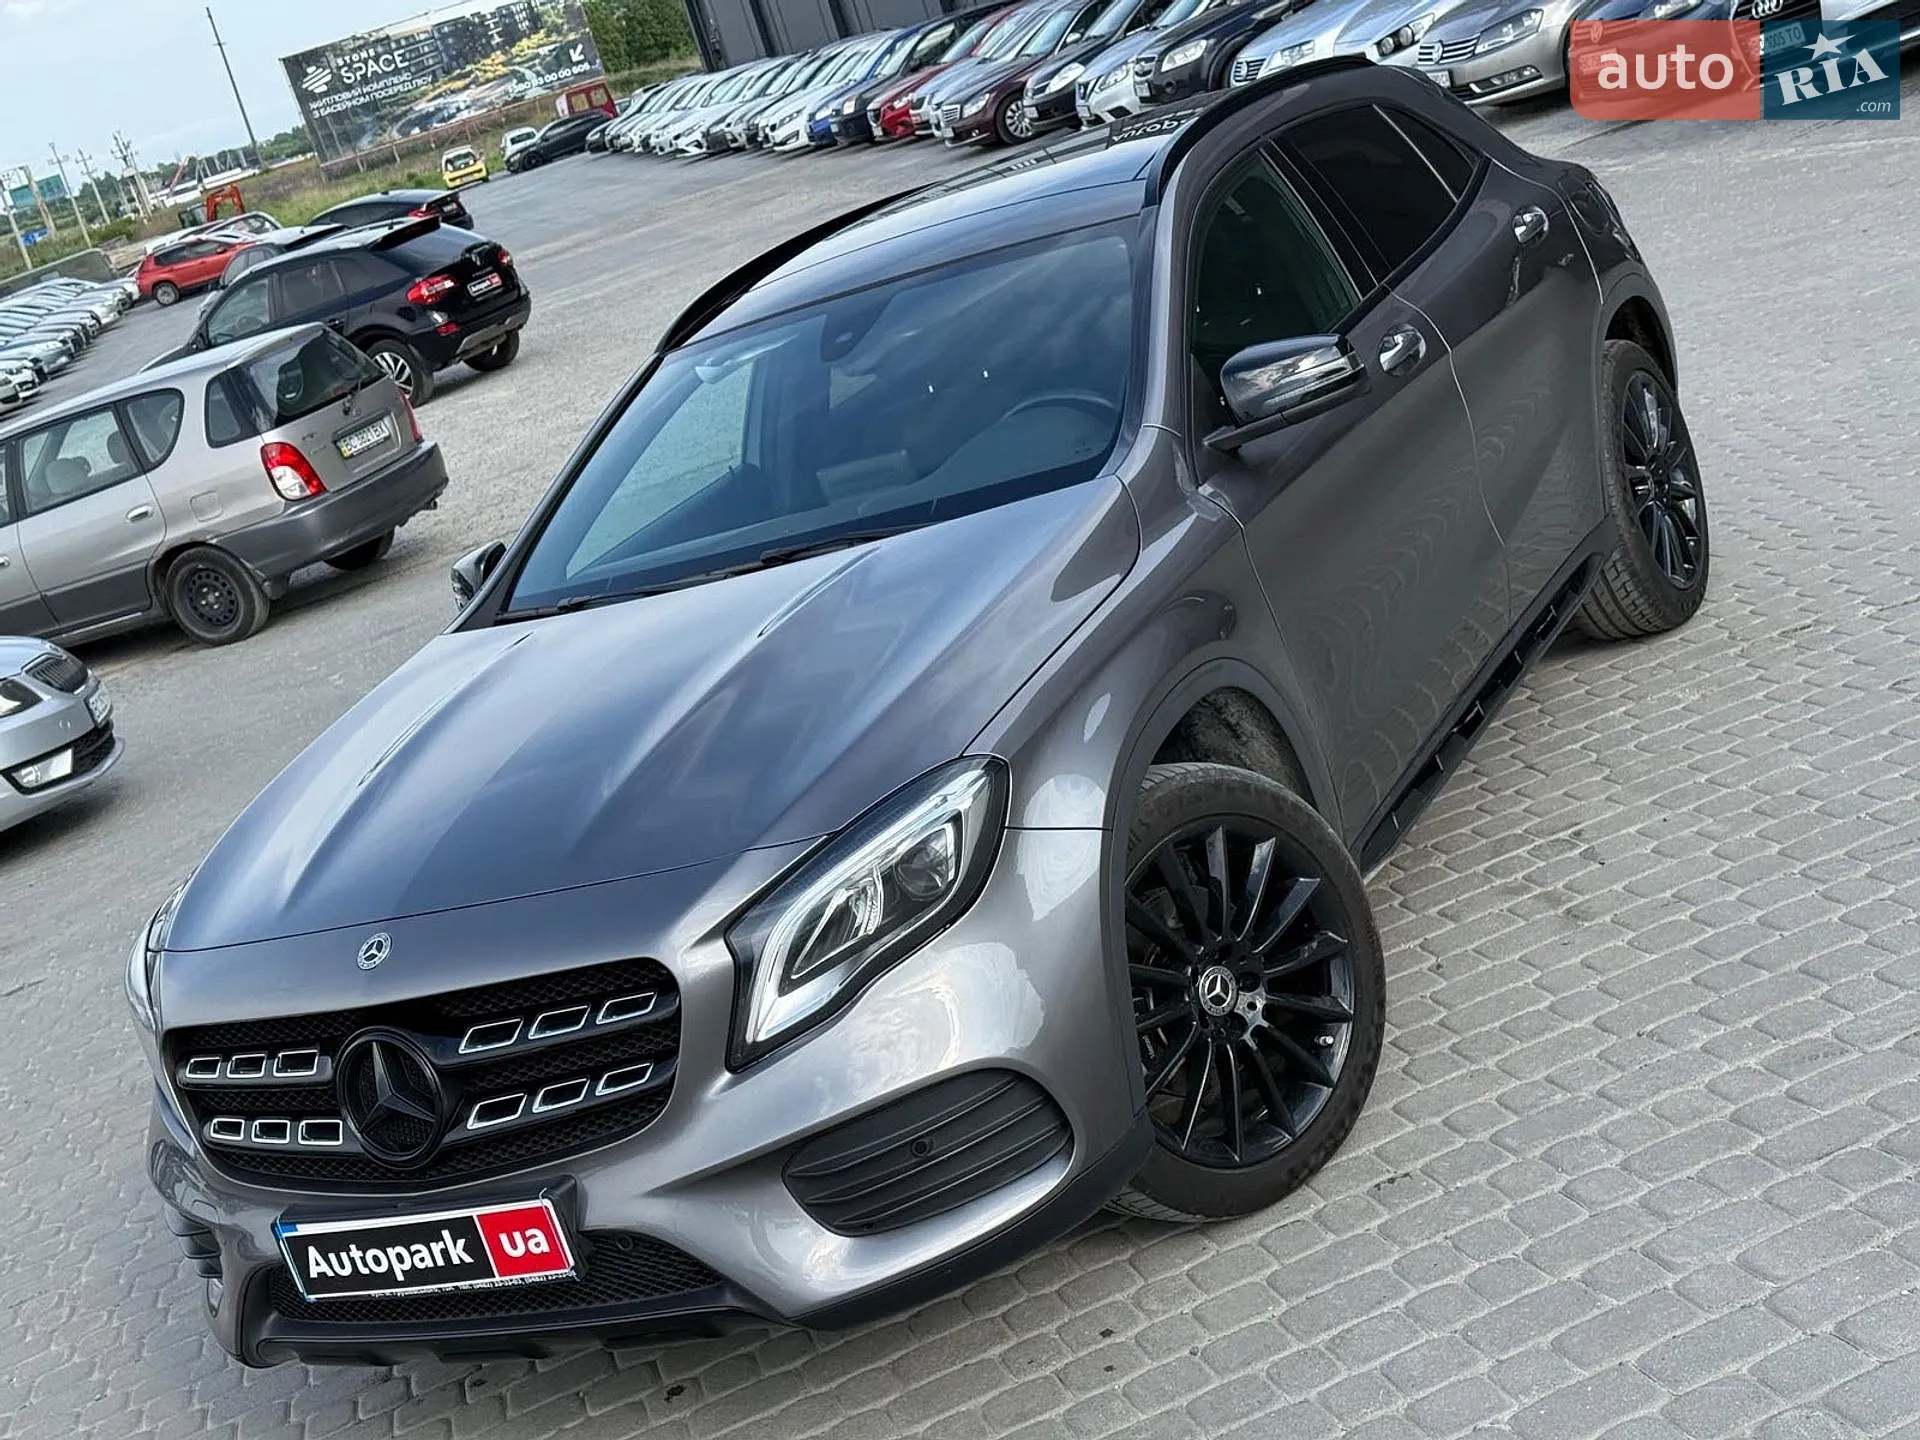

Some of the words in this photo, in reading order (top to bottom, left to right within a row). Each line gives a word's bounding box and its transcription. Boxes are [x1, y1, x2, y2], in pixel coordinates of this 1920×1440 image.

[336, 48, 376, 67] STONE
[340, 49, 409, 84] SPACE
[309, 86, 362, 110] ЖИТЛОВИЙ
[362, 72, 412, 95] КОМПЛЕКС
[320, 95, 370, 117] БАСЕЙНОМ
[308, 1229, 474, 1281] Autopark
[499, 1227, 550, 1258] ua
